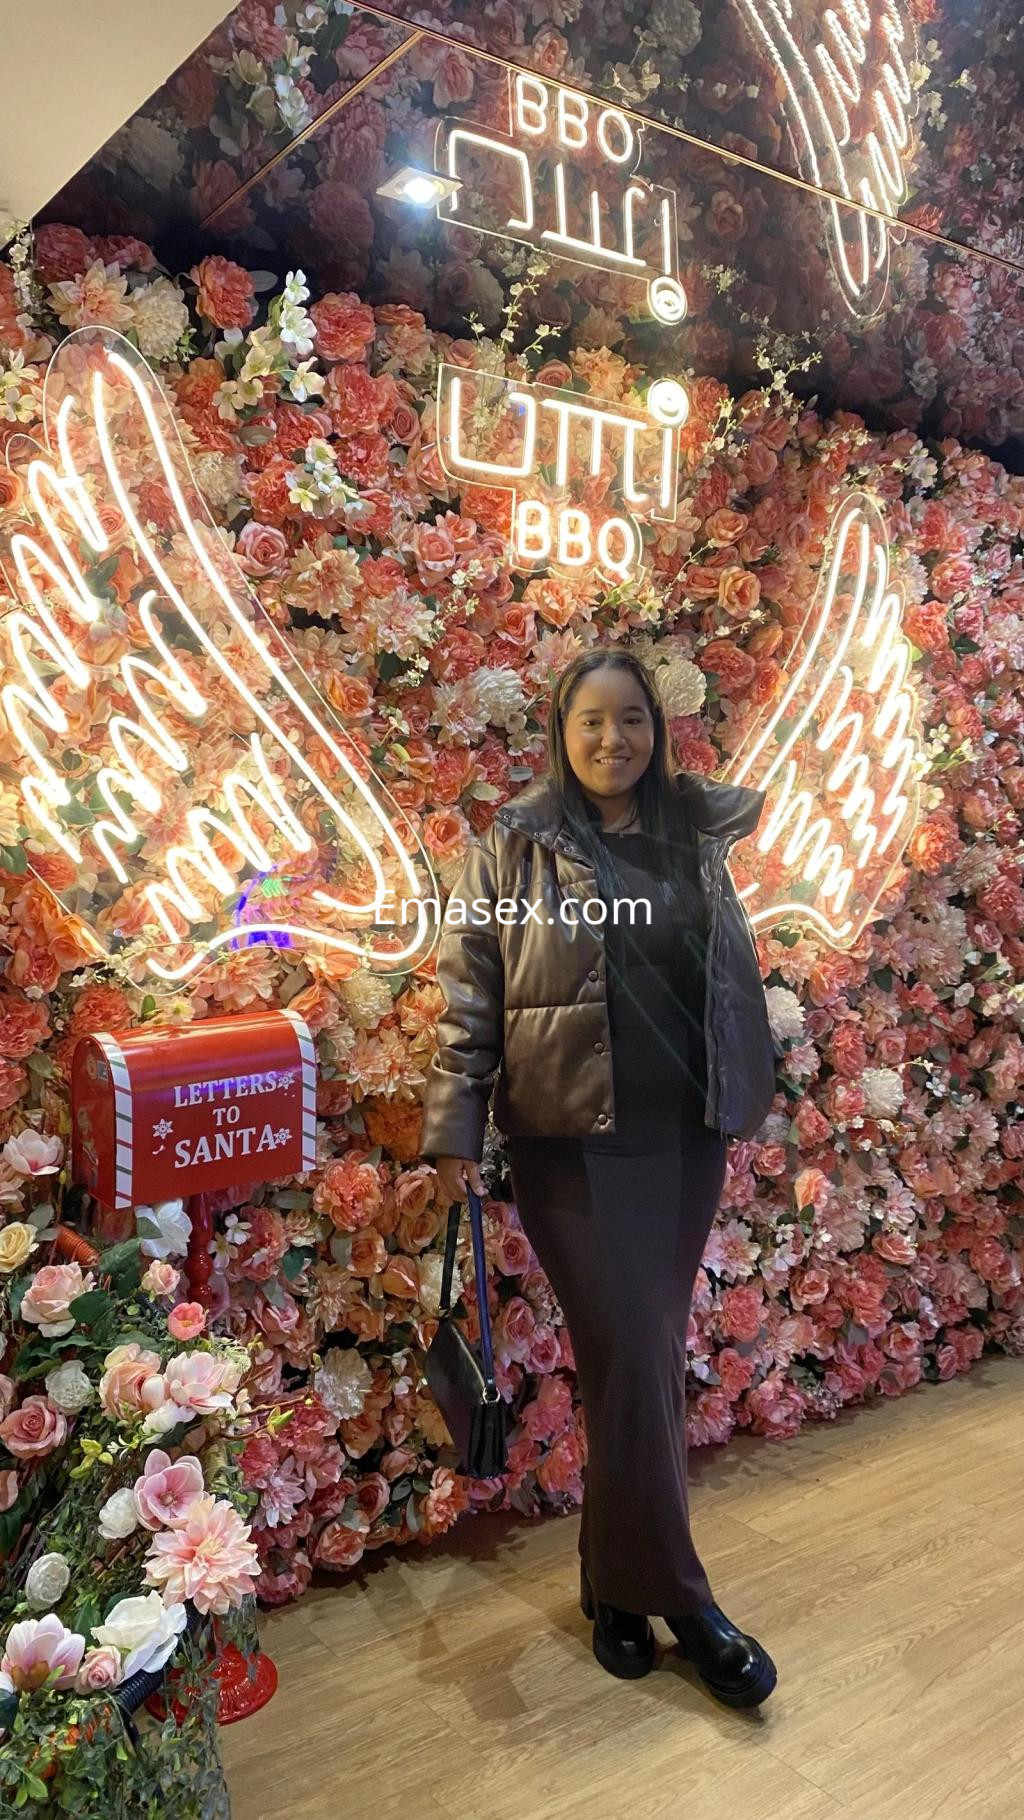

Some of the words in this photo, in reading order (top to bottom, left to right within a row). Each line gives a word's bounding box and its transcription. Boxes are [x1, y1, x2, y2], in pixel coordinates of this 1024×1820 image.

[516, 499, 637, 579] BBQ
[173, 1070, 279, 1108] LETTERS
[212, 1105, 241, 1126] TO
[173, 1123, 278, 1169] SANTA
